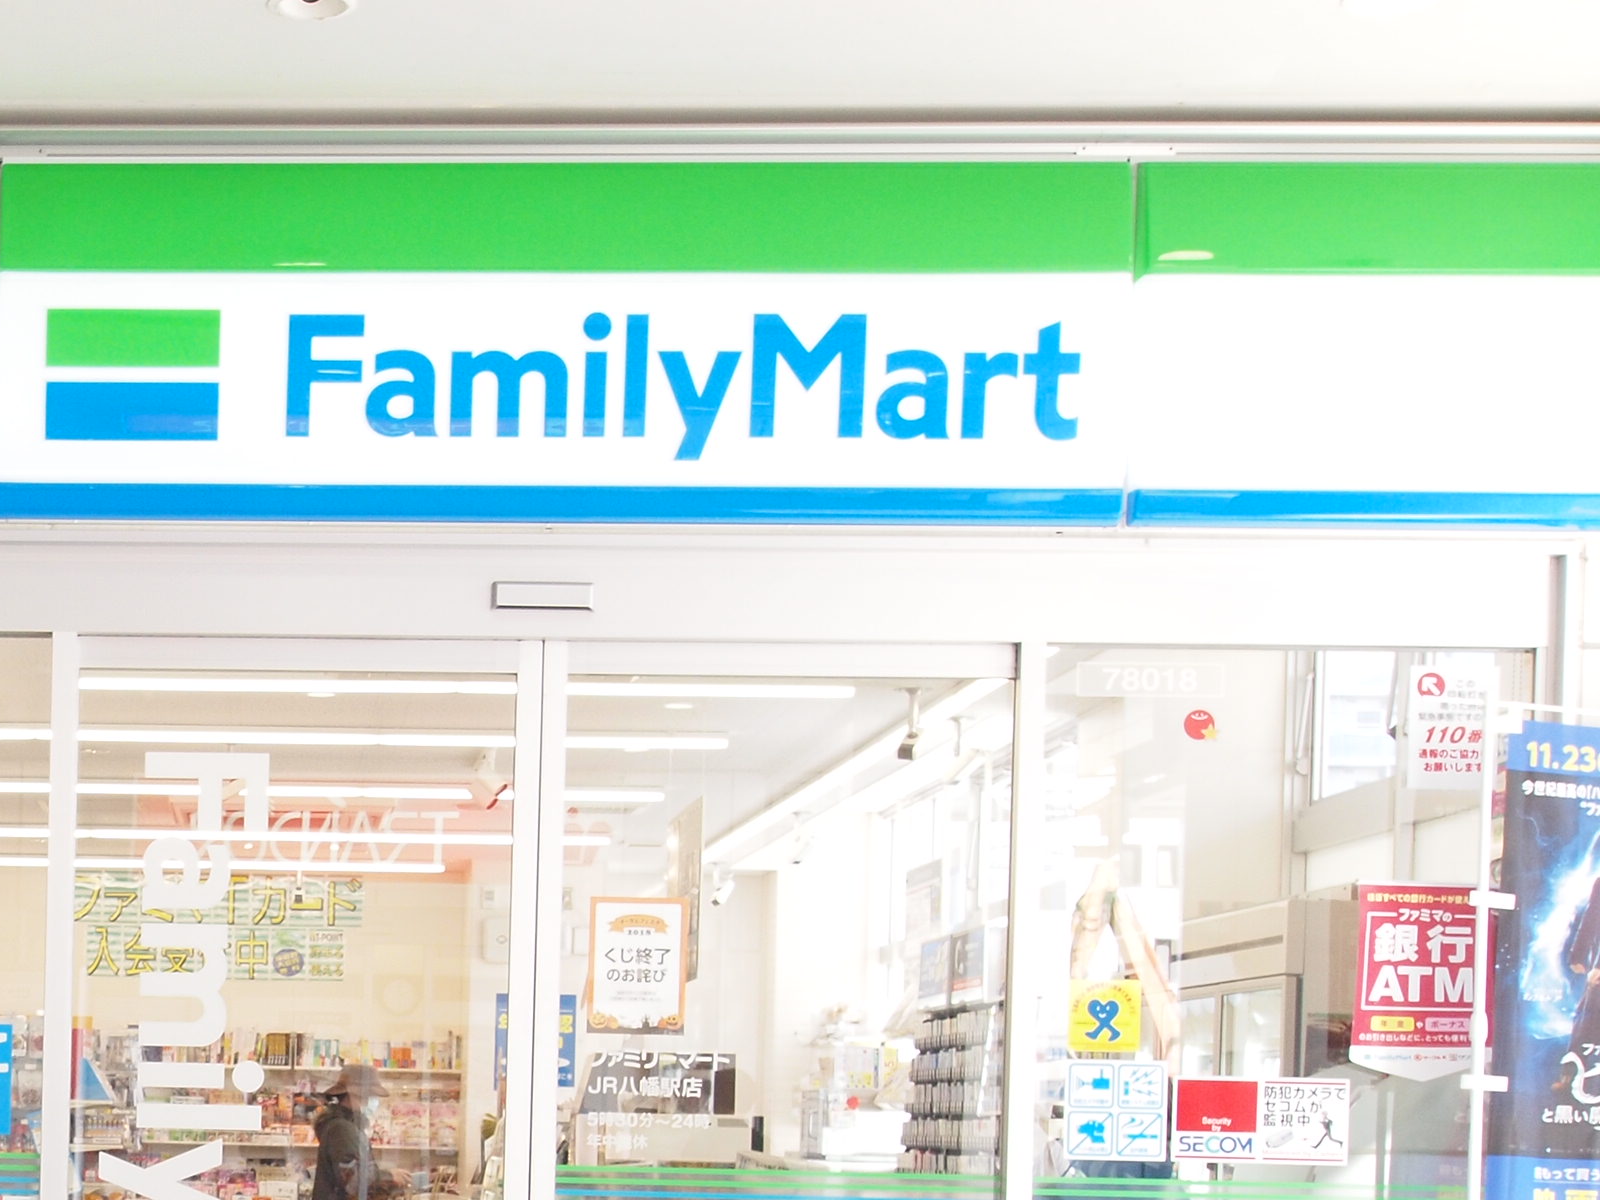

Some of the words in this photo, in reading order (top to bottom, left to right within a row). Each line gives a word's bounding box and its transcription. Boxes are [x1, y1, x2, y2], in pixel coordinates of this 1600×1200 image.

[286, 311, 1081, 460] FamilyMart
[1103, 668, 1198, 691] 78018
[1426, 726, 1482, 743] 110番
[1398, 908, 1452, 922] ファミマの
[1374, 923, 1473, 963] 銀行
[87, 928, 269, 979] 入会受中
[604, 948, 671, 965] くじ終了
[607, 968, 666, 984] のお詫び
[1368, 965, 1473, 1003] ATM
[1431, 1020, 1466, 1028] ボーナス
[591, 1051, 730, 1072] ファミリーマート
[588, 1077, 703, 1098] JR八幡駅店
[1264, 1086, 1346, 1100] 防犯カメラで
[1264, 1101, 1322, 1113] セコムが
[1202, 1116, 1231, 1127] Security
[1264, 1115, 1311, 1127] 監視中
[1179, 1136, 1252, 1154] SECOM
